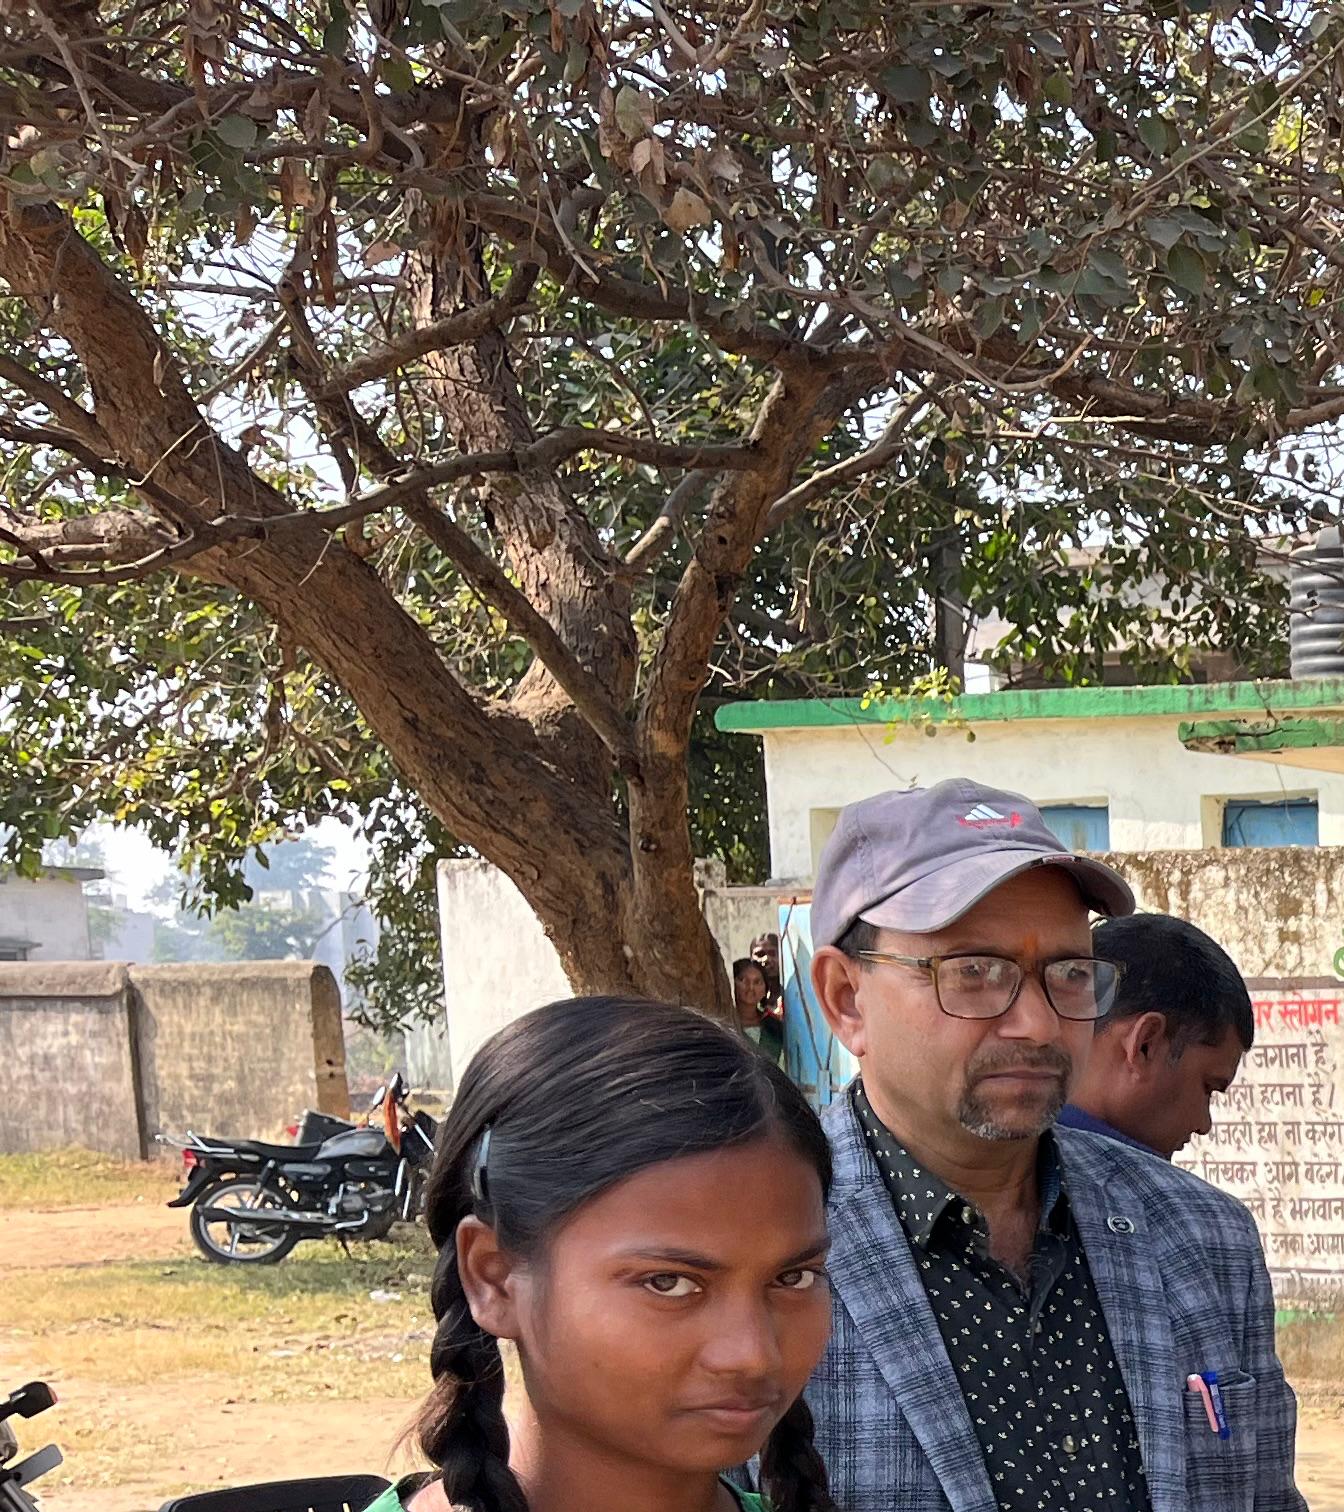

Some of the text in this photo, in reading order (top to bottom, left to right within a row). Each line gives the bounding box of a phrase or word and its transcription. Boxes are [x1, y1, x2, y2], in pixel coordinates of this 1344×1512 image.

[1252, 1043, 1307, 1070] जगाना
[1258, 1083, 1305, 1112] हटाना
[1255, 1122, 1278, 1151] हम
[1282, 1122, 1302, 1146] ना
[1264, 1152, 1301, 1185] आगे
